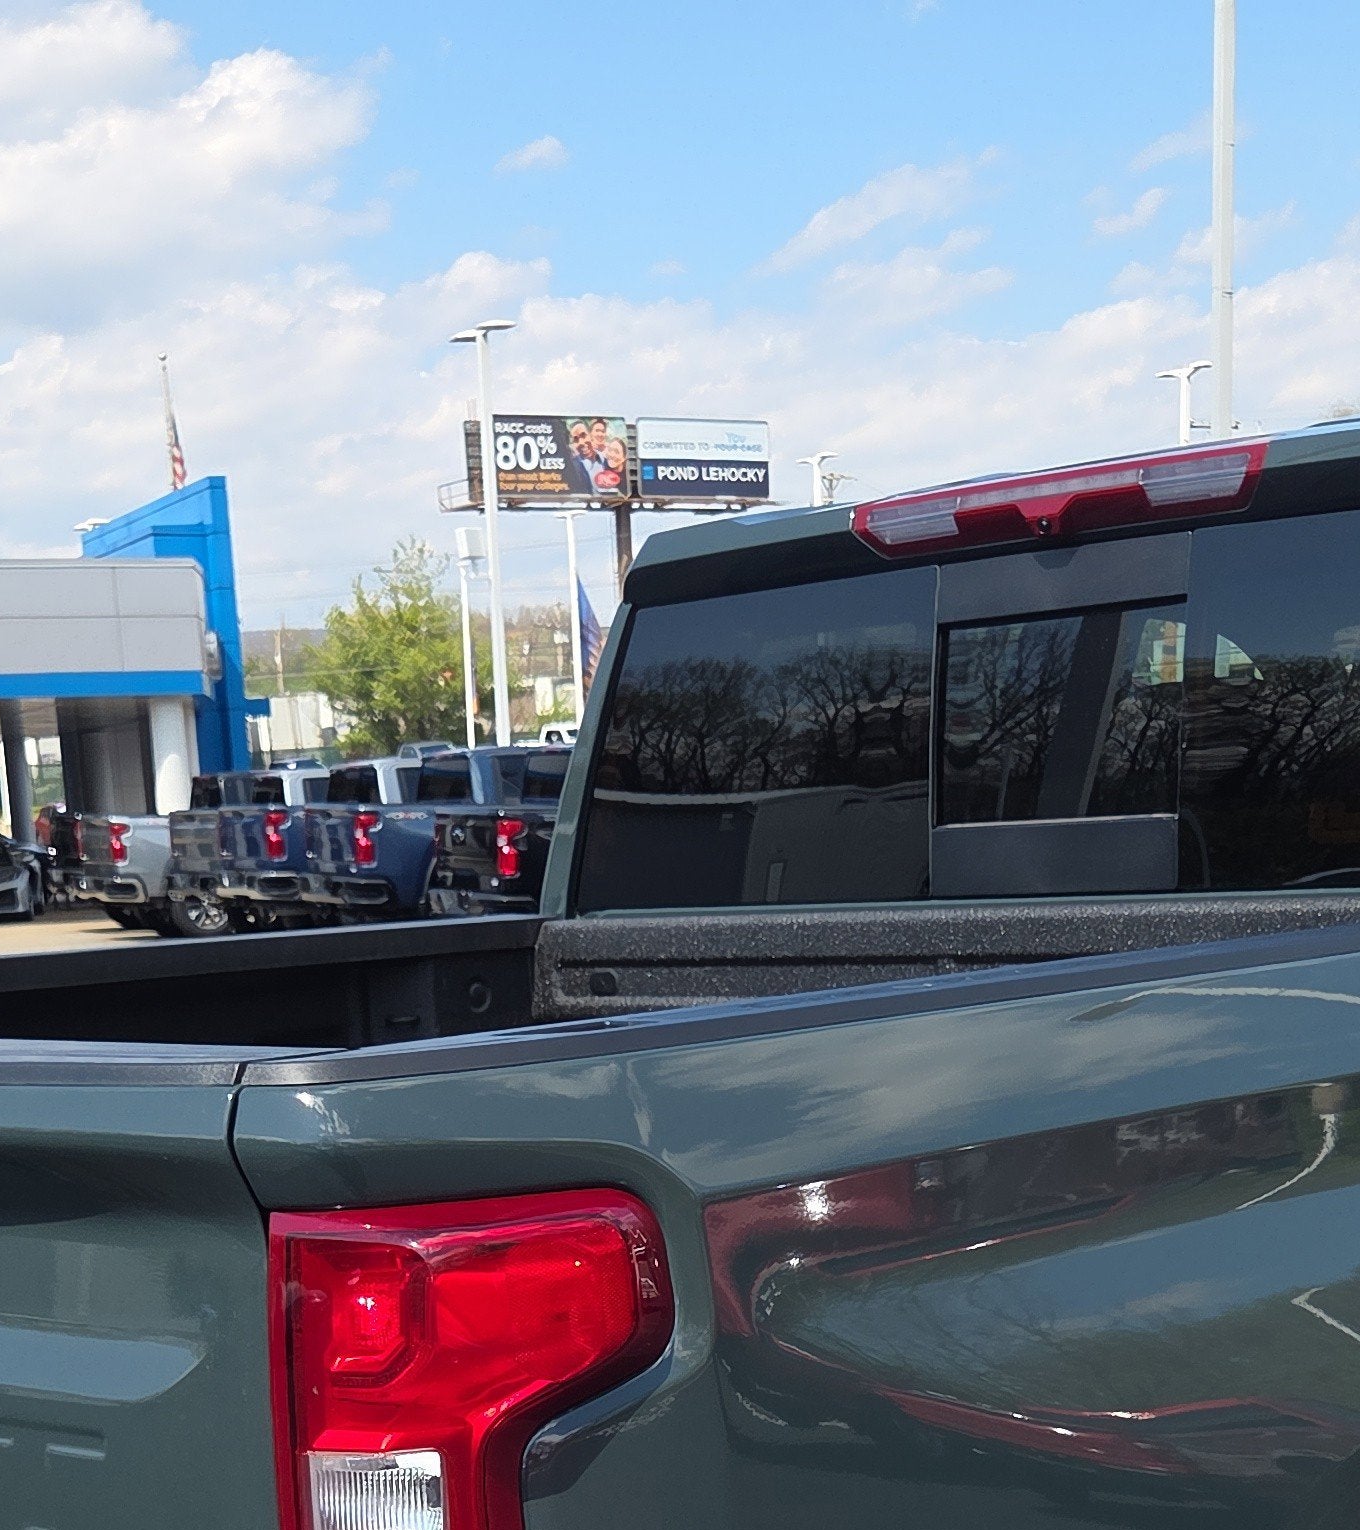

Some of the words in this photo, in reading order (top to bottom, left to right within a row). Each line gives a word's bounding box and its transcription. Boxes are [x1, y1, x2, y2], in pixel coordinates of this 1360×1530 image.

[495, 422, 524, 434] RACC
[496, 435, 557, 471] 80%
[642, 441, 696, 452] COMMITTED
[698, 442, 710, 452] TO
[539, 457, 566, 470] LESS
[657, 465, 699, 481] POND
[702, 466, 767, 483] LEHOCKY
